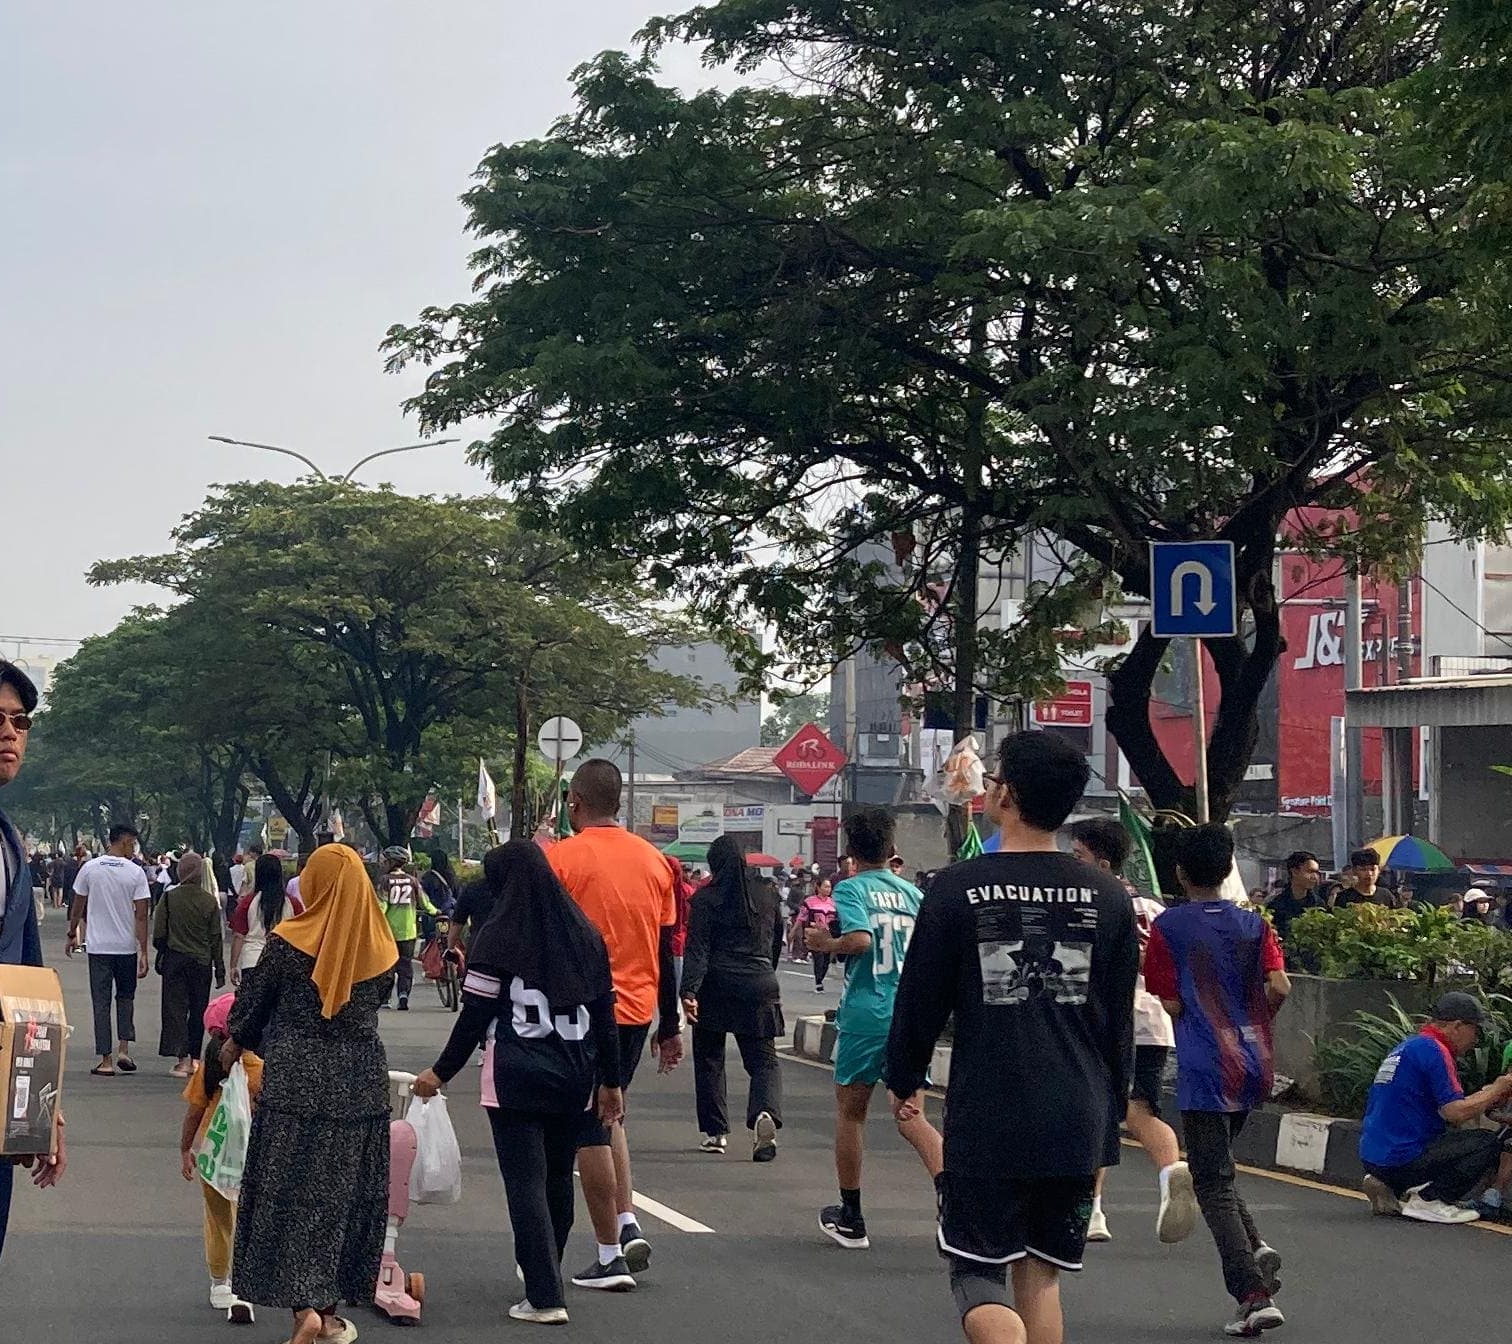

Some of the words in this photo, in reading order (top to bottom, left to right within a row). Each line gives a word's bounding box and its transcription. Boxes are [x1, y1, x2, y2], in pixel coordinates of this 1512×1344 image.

[389, 885, 413, 905] 02
[870, 891, 907, 909] FASTA
[966, 884, 1093, 904] EVACUATION
